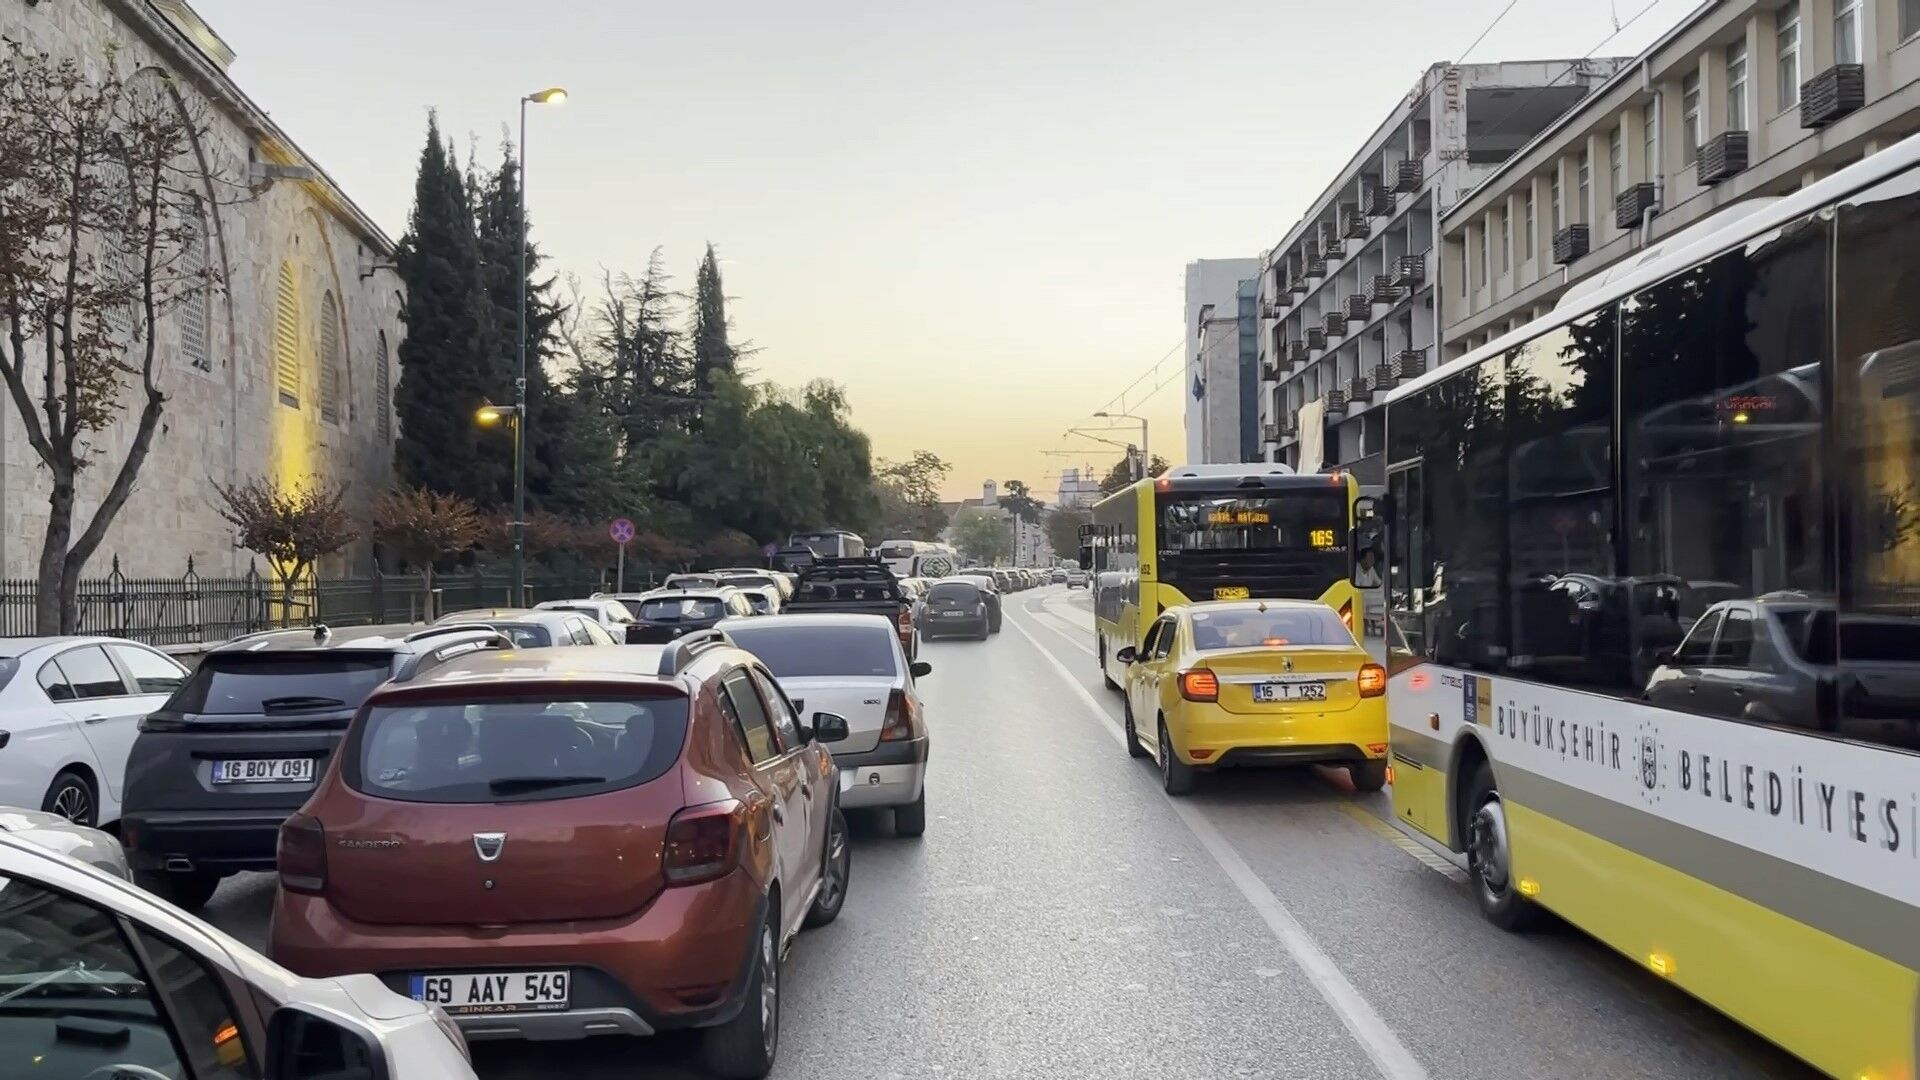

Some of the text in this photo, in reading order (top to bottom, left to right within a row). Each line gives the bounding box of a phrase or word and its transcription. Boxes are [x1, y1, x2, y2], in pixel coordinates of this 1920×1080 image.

[1262, 686, 1324, 697] 16 T 1252
[1498, 699, 1621, 771] BÜYÜKŞEHİR
[225, 760, 310, 777] 16 BOY 091
[425, 974, 566, 1003] 69 AAY 549
